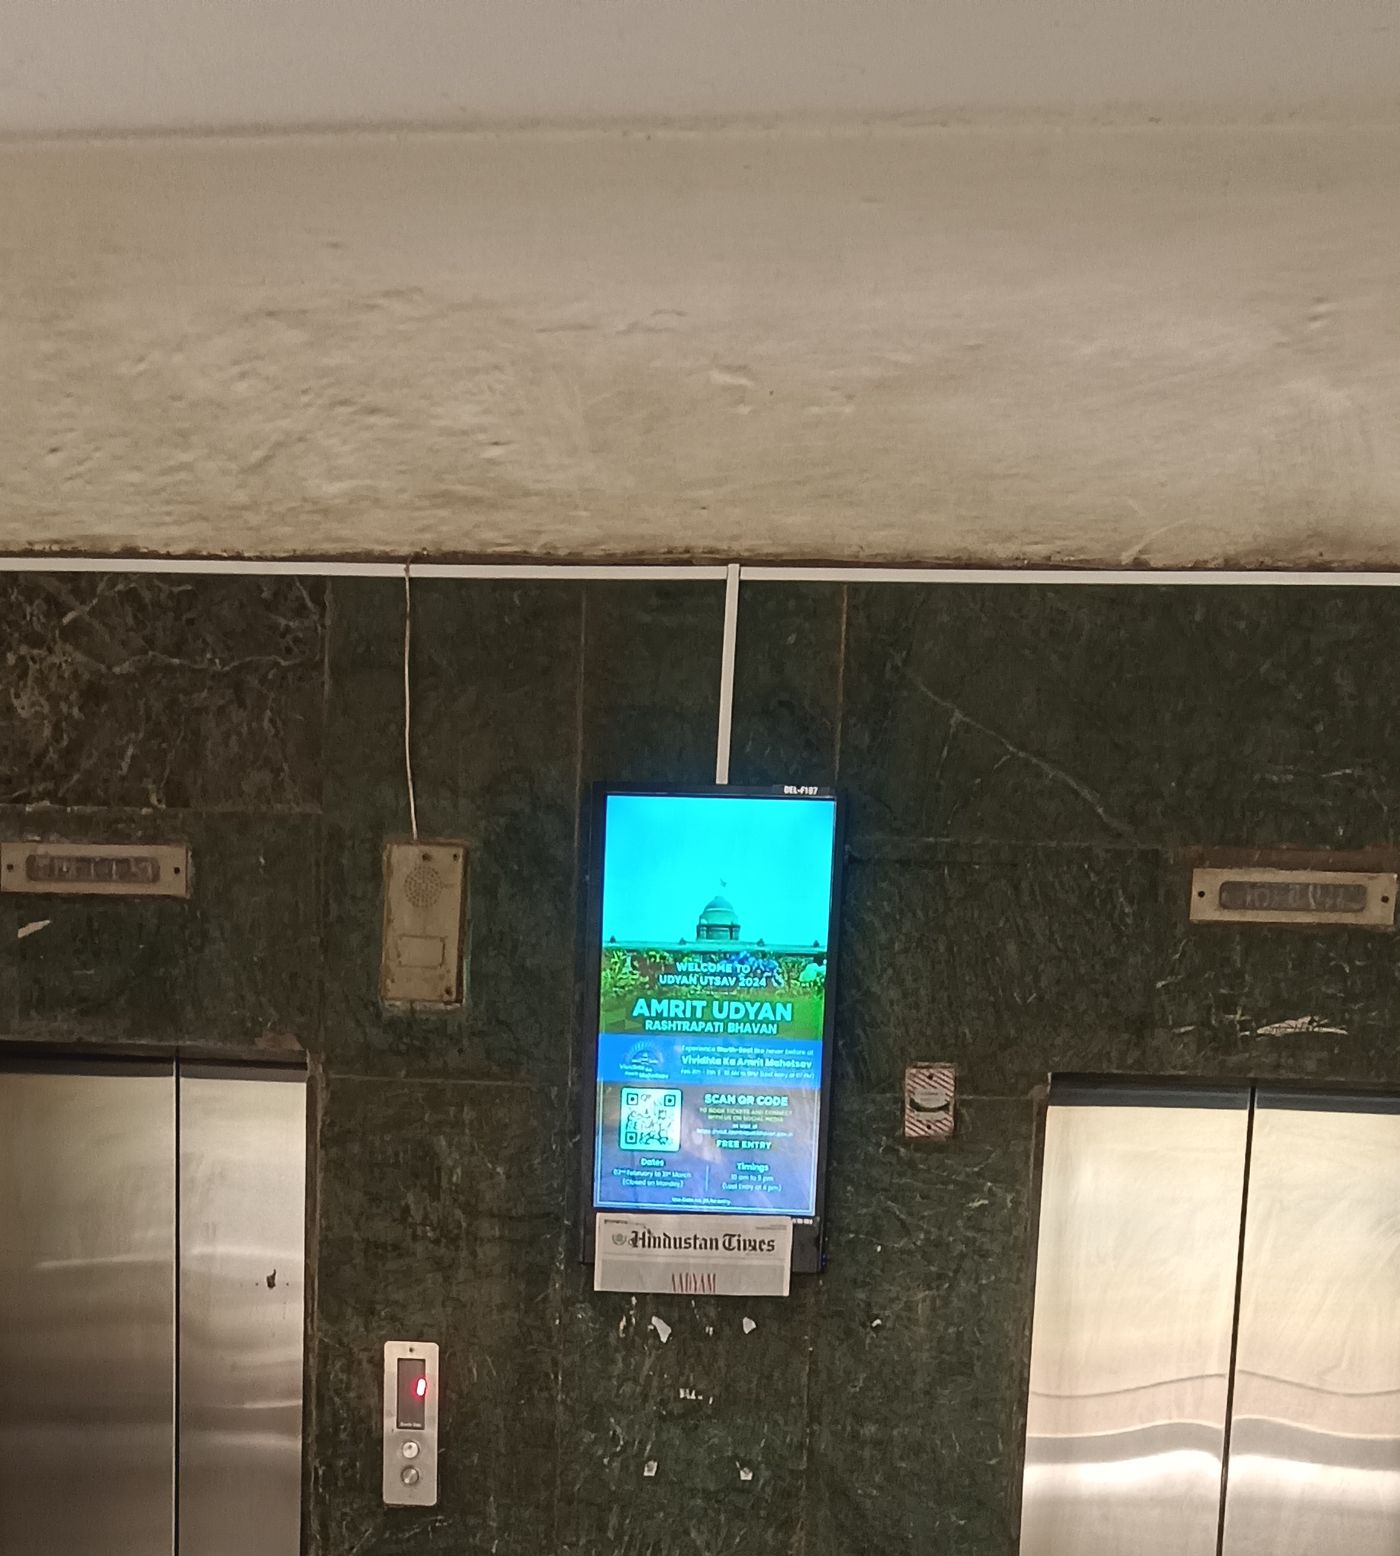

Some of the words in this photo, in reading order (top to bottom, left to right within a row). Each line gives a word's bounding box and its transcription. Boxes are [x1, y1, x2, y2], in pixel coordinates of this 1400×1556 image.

[676, 962, 732, 974] WELCOME
[737, 963, 750, 974] TO
[659, 974, 697, 986] UDYAN
[700, 975, 736, 987] UTSAV
[739, 976, 767, 988] 2024
[632, 999, 707, 1019] AMRIT
[712, 1001, 793, 1022] UDYAN
[645, 1019, 724, 1033] RASHTRAPATI
[727, 1022, 778, 1034] BHAVAN
[723, 1057, 736, 1066] Ka
[765, 1058, 812, 1069] Mahotsav
[704, 1094, 736, 1105] SCAN
[738, 1095, 755, 1105] QR
[756, 1096, 788, 1106] CODE
[716, 1139, 740, 1148] FREE
[742, 1140, 772, 1150] ENTRY
[640, 1157, 665, 1167] Dates
[736, 1162, 769, 1173] Timings
[628, 1230, 719, 1251] Hindustan
[722, 1232, 776, 1252] Times
